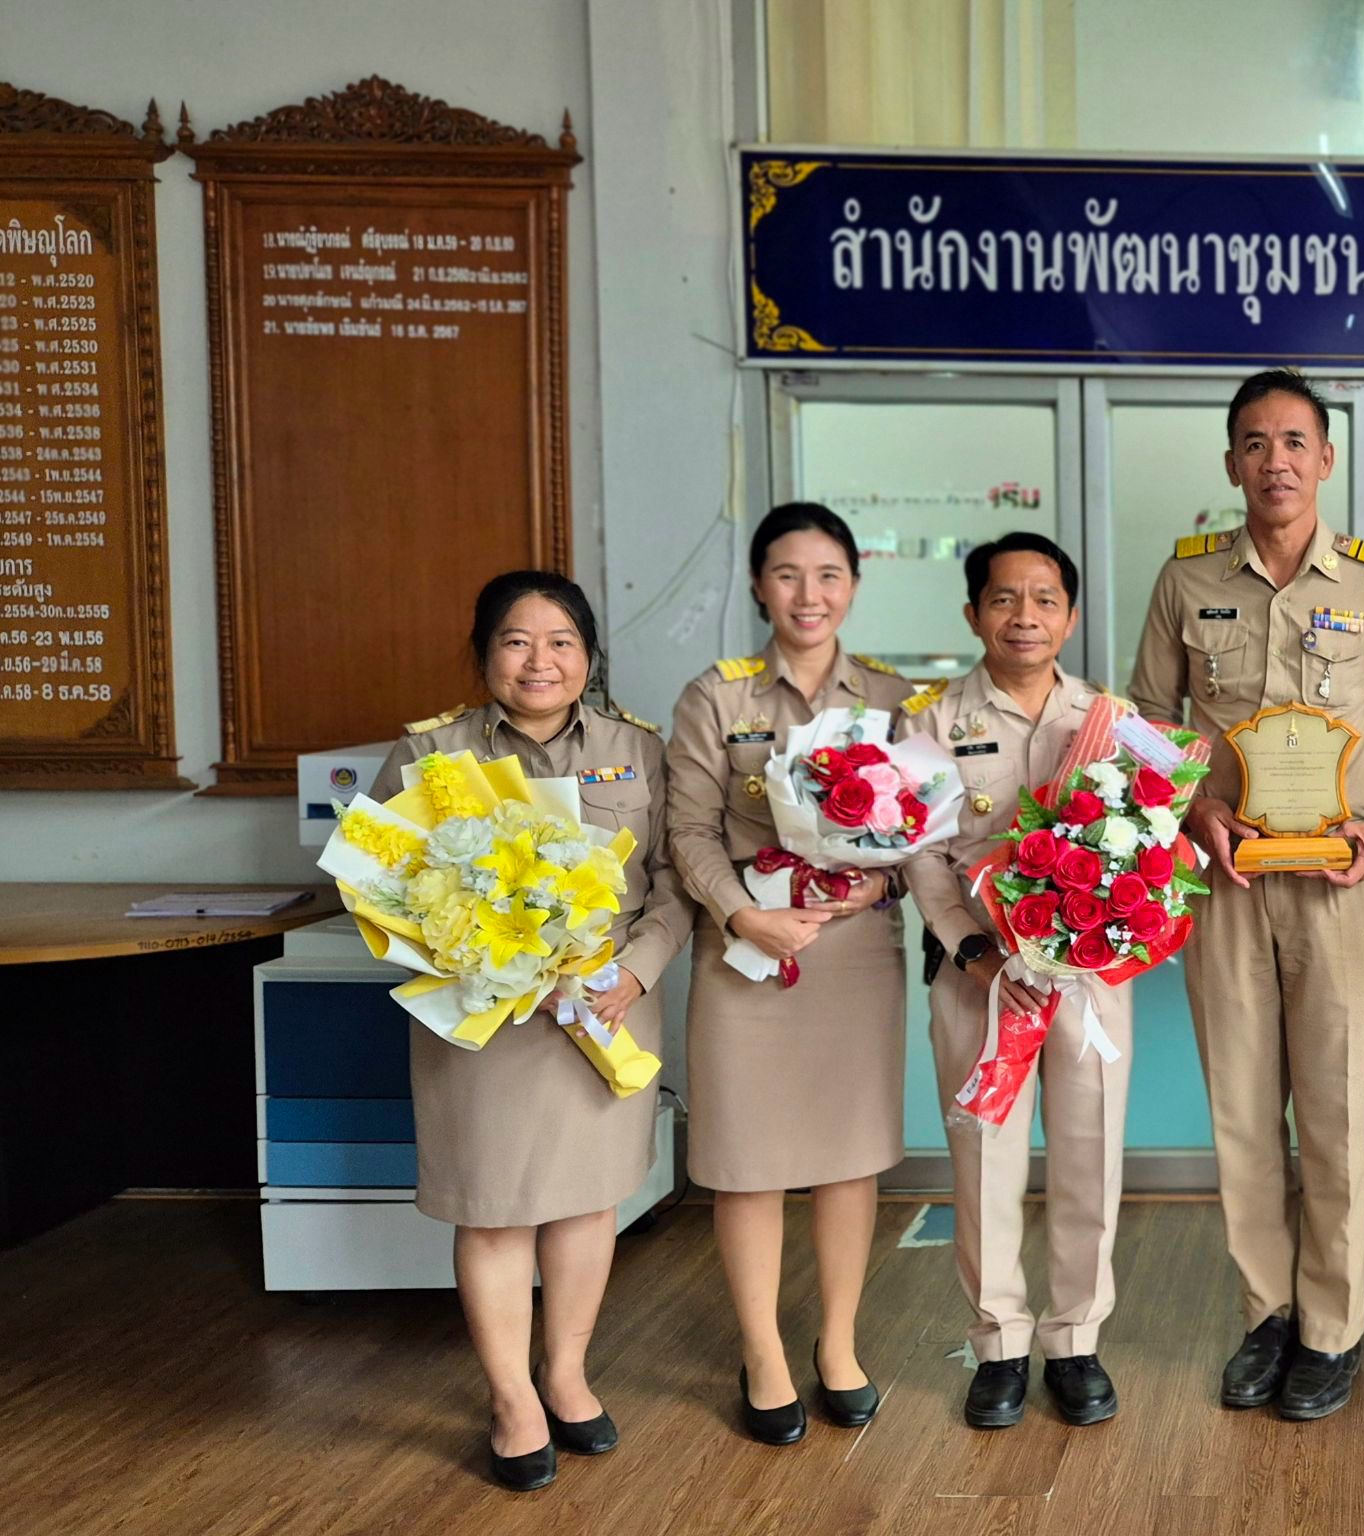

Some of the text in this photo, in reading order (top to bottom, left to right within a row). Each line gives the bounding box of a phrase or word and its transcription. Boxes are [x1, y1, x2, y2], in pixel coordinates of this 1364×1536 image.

[31, 273, 95, 288] พ.ศ.2520
[33, 295, 96, 310] พ.ศ.2523
[34, 317, 97, 332] พ.ศ.2525
[35, 339, 98, 354] พ.ศ.2530
[35, 361, 98, 375] พ.ศ.2531
